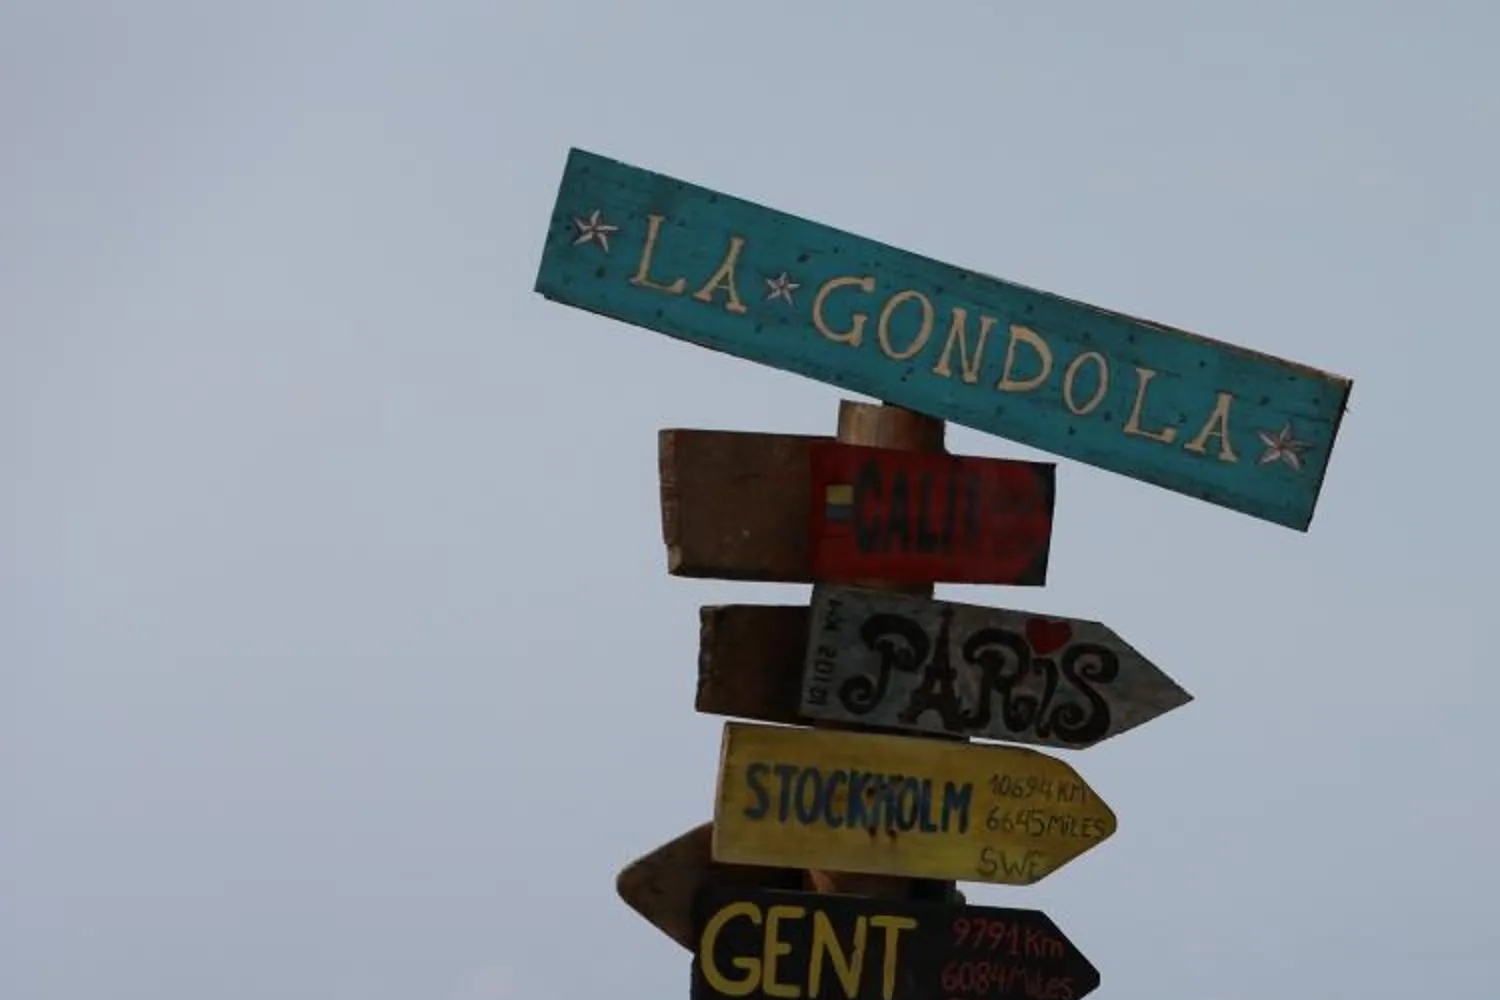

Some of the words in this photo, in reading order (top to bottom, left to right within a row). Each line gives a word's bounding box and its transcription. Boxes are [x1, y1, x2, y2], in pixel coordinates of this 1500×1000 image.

[630, 214, 750, 315] LA
[811, 274, 1239, 463] GONDOLA
[838, 605, 1120, 744] PARIS
[742, 763, 974, 834] STOCKHOLM
[986, 806, 1045, 837] 6645
[976, 846, 1045, 880] SWE
[952, 917, 1019, 955] 9791
